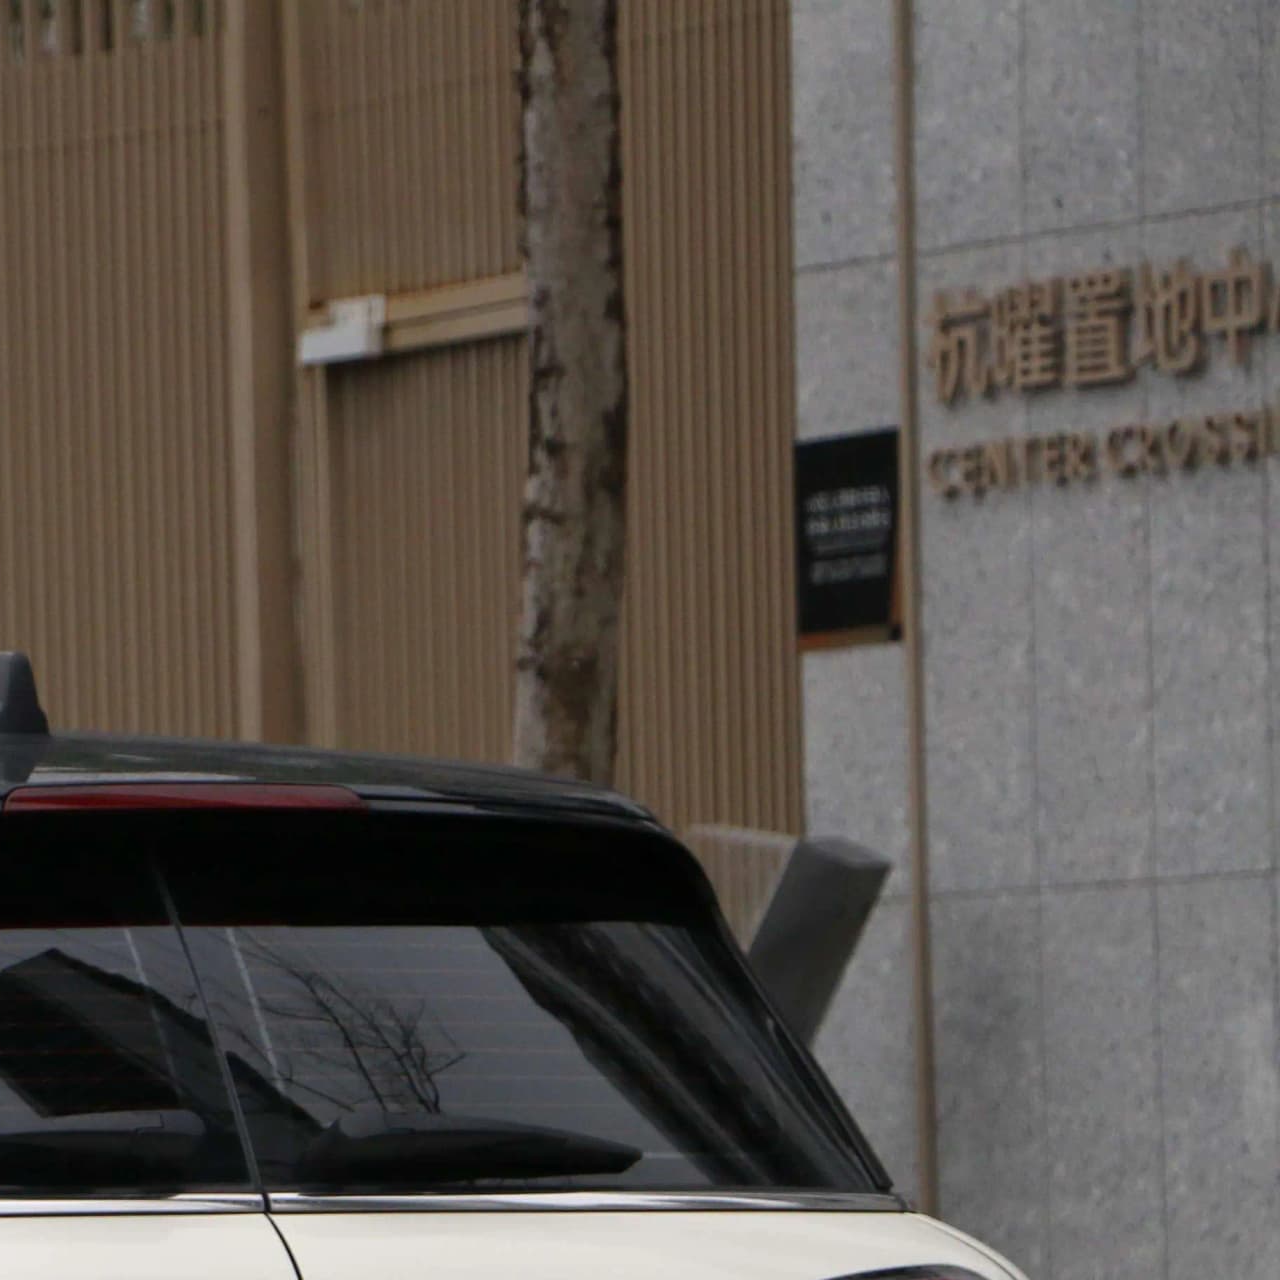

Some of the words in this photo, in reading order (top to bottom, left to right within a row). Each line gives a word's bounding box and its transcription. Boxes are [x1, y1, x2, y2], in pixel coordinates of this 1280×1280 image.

[930, 247, 1280, 405] 杭曜置地中
[929, 432, 1095, 499] CENTER
